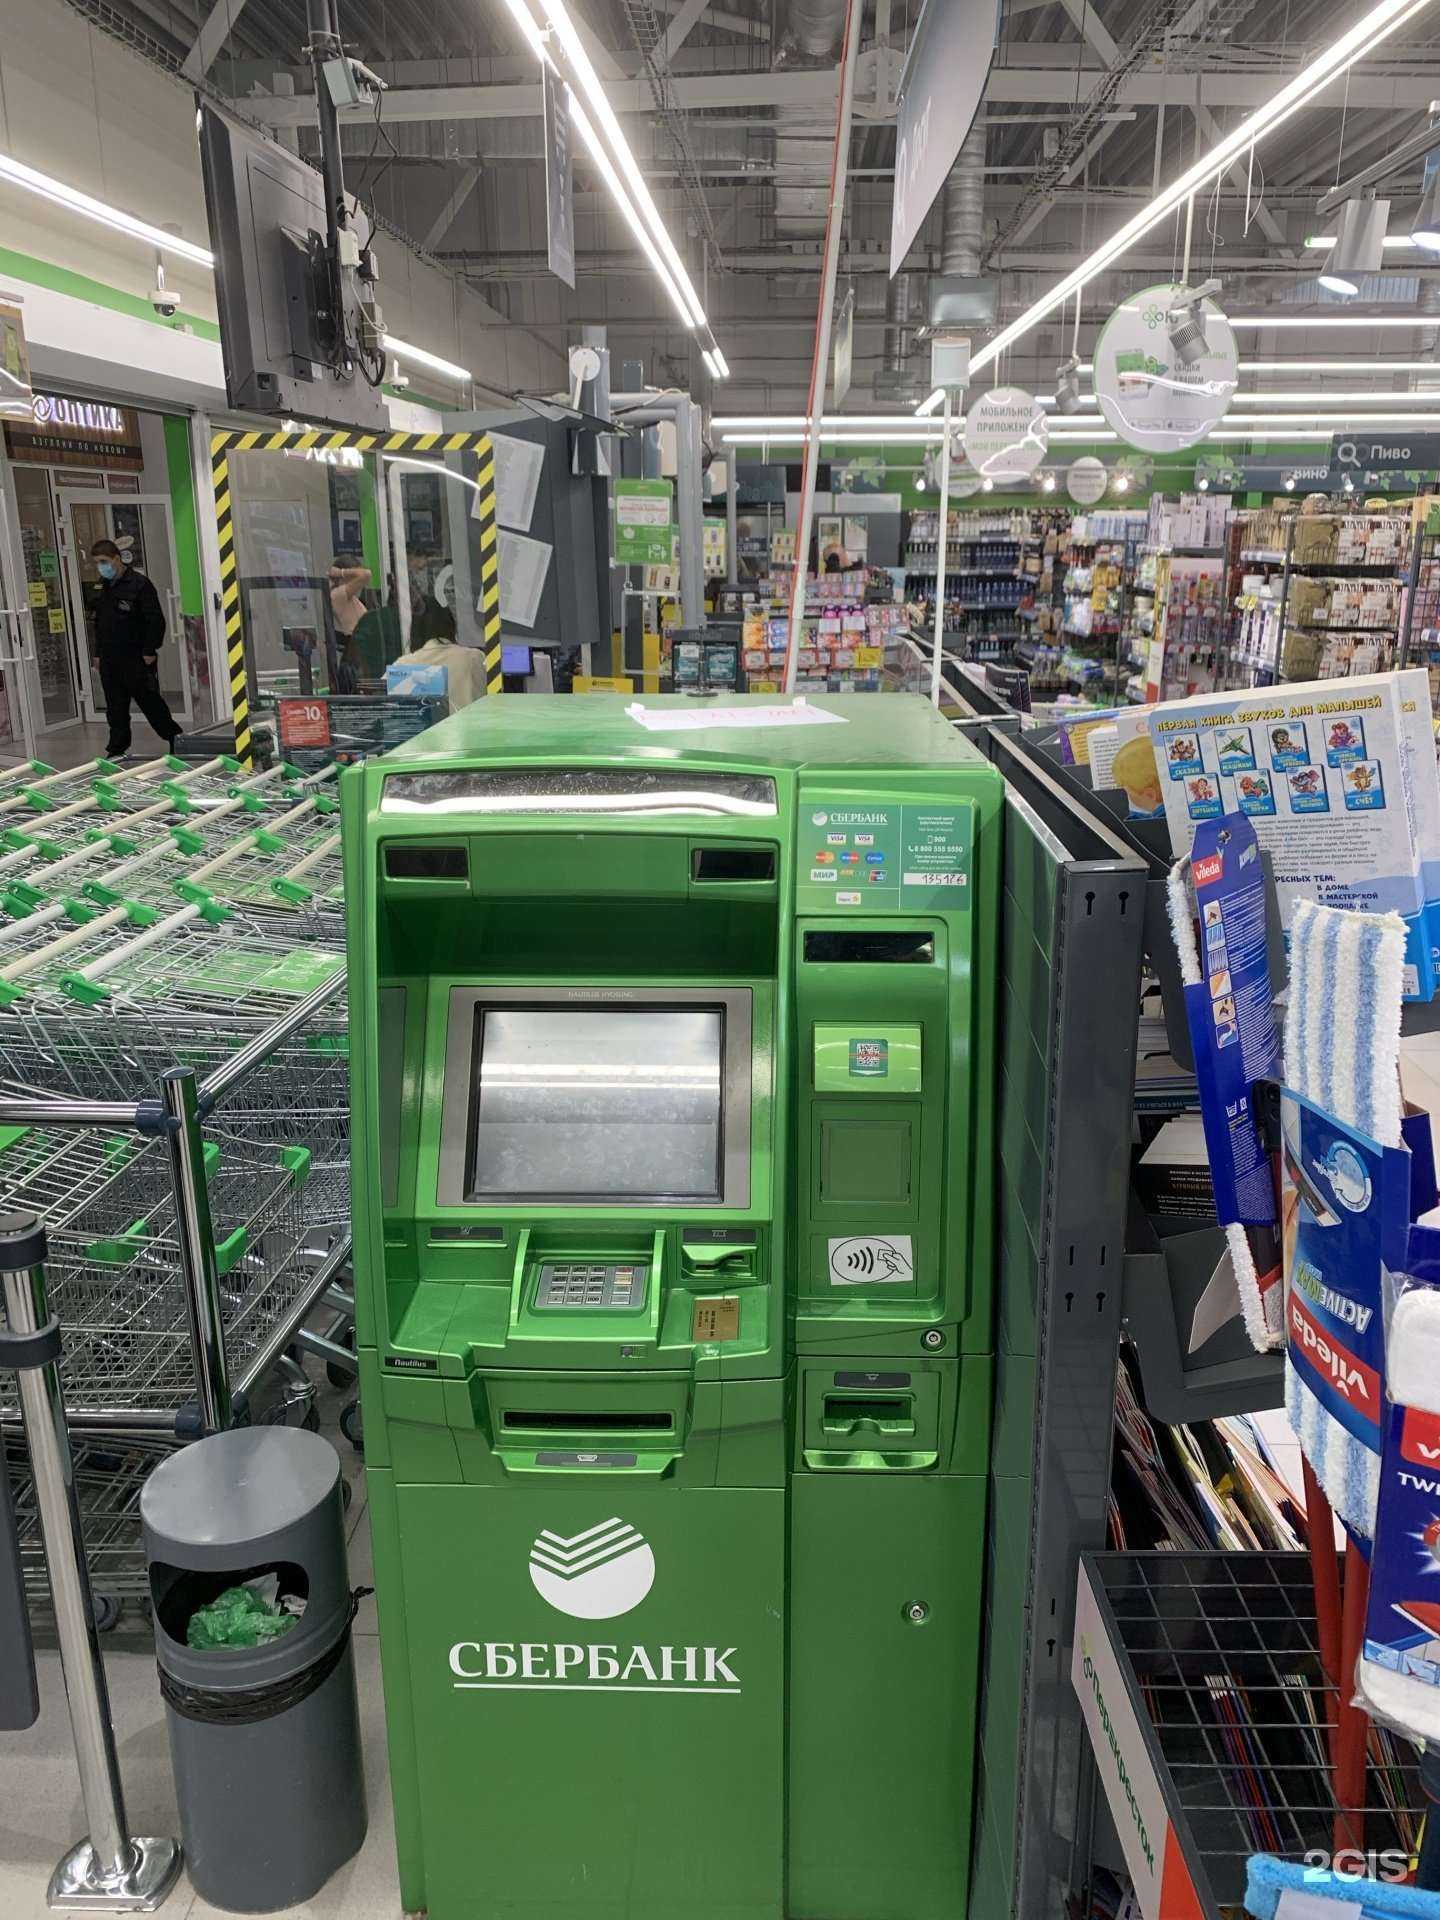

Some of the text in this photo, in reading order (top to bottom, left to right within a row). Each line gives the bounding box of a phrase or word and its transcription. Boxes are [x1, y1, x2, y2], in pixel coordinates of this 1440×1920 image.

[980, 407, 1033, 417] МОБИЛЬНОЕ
[976, 422, 1029, 433] ПРИЛОЖЕН
[1371, 445, 1411, 460] Пиво
[1157, 697, 1382, 732] ПЕРВАЯ КНИГА ЗВУКОВ ДЛЯ МАЛЫШЕЙ
[830, 813, 888, 823] СБЕРБАНК
[448, 1641, 741, 1683] СБЕРБАНК
